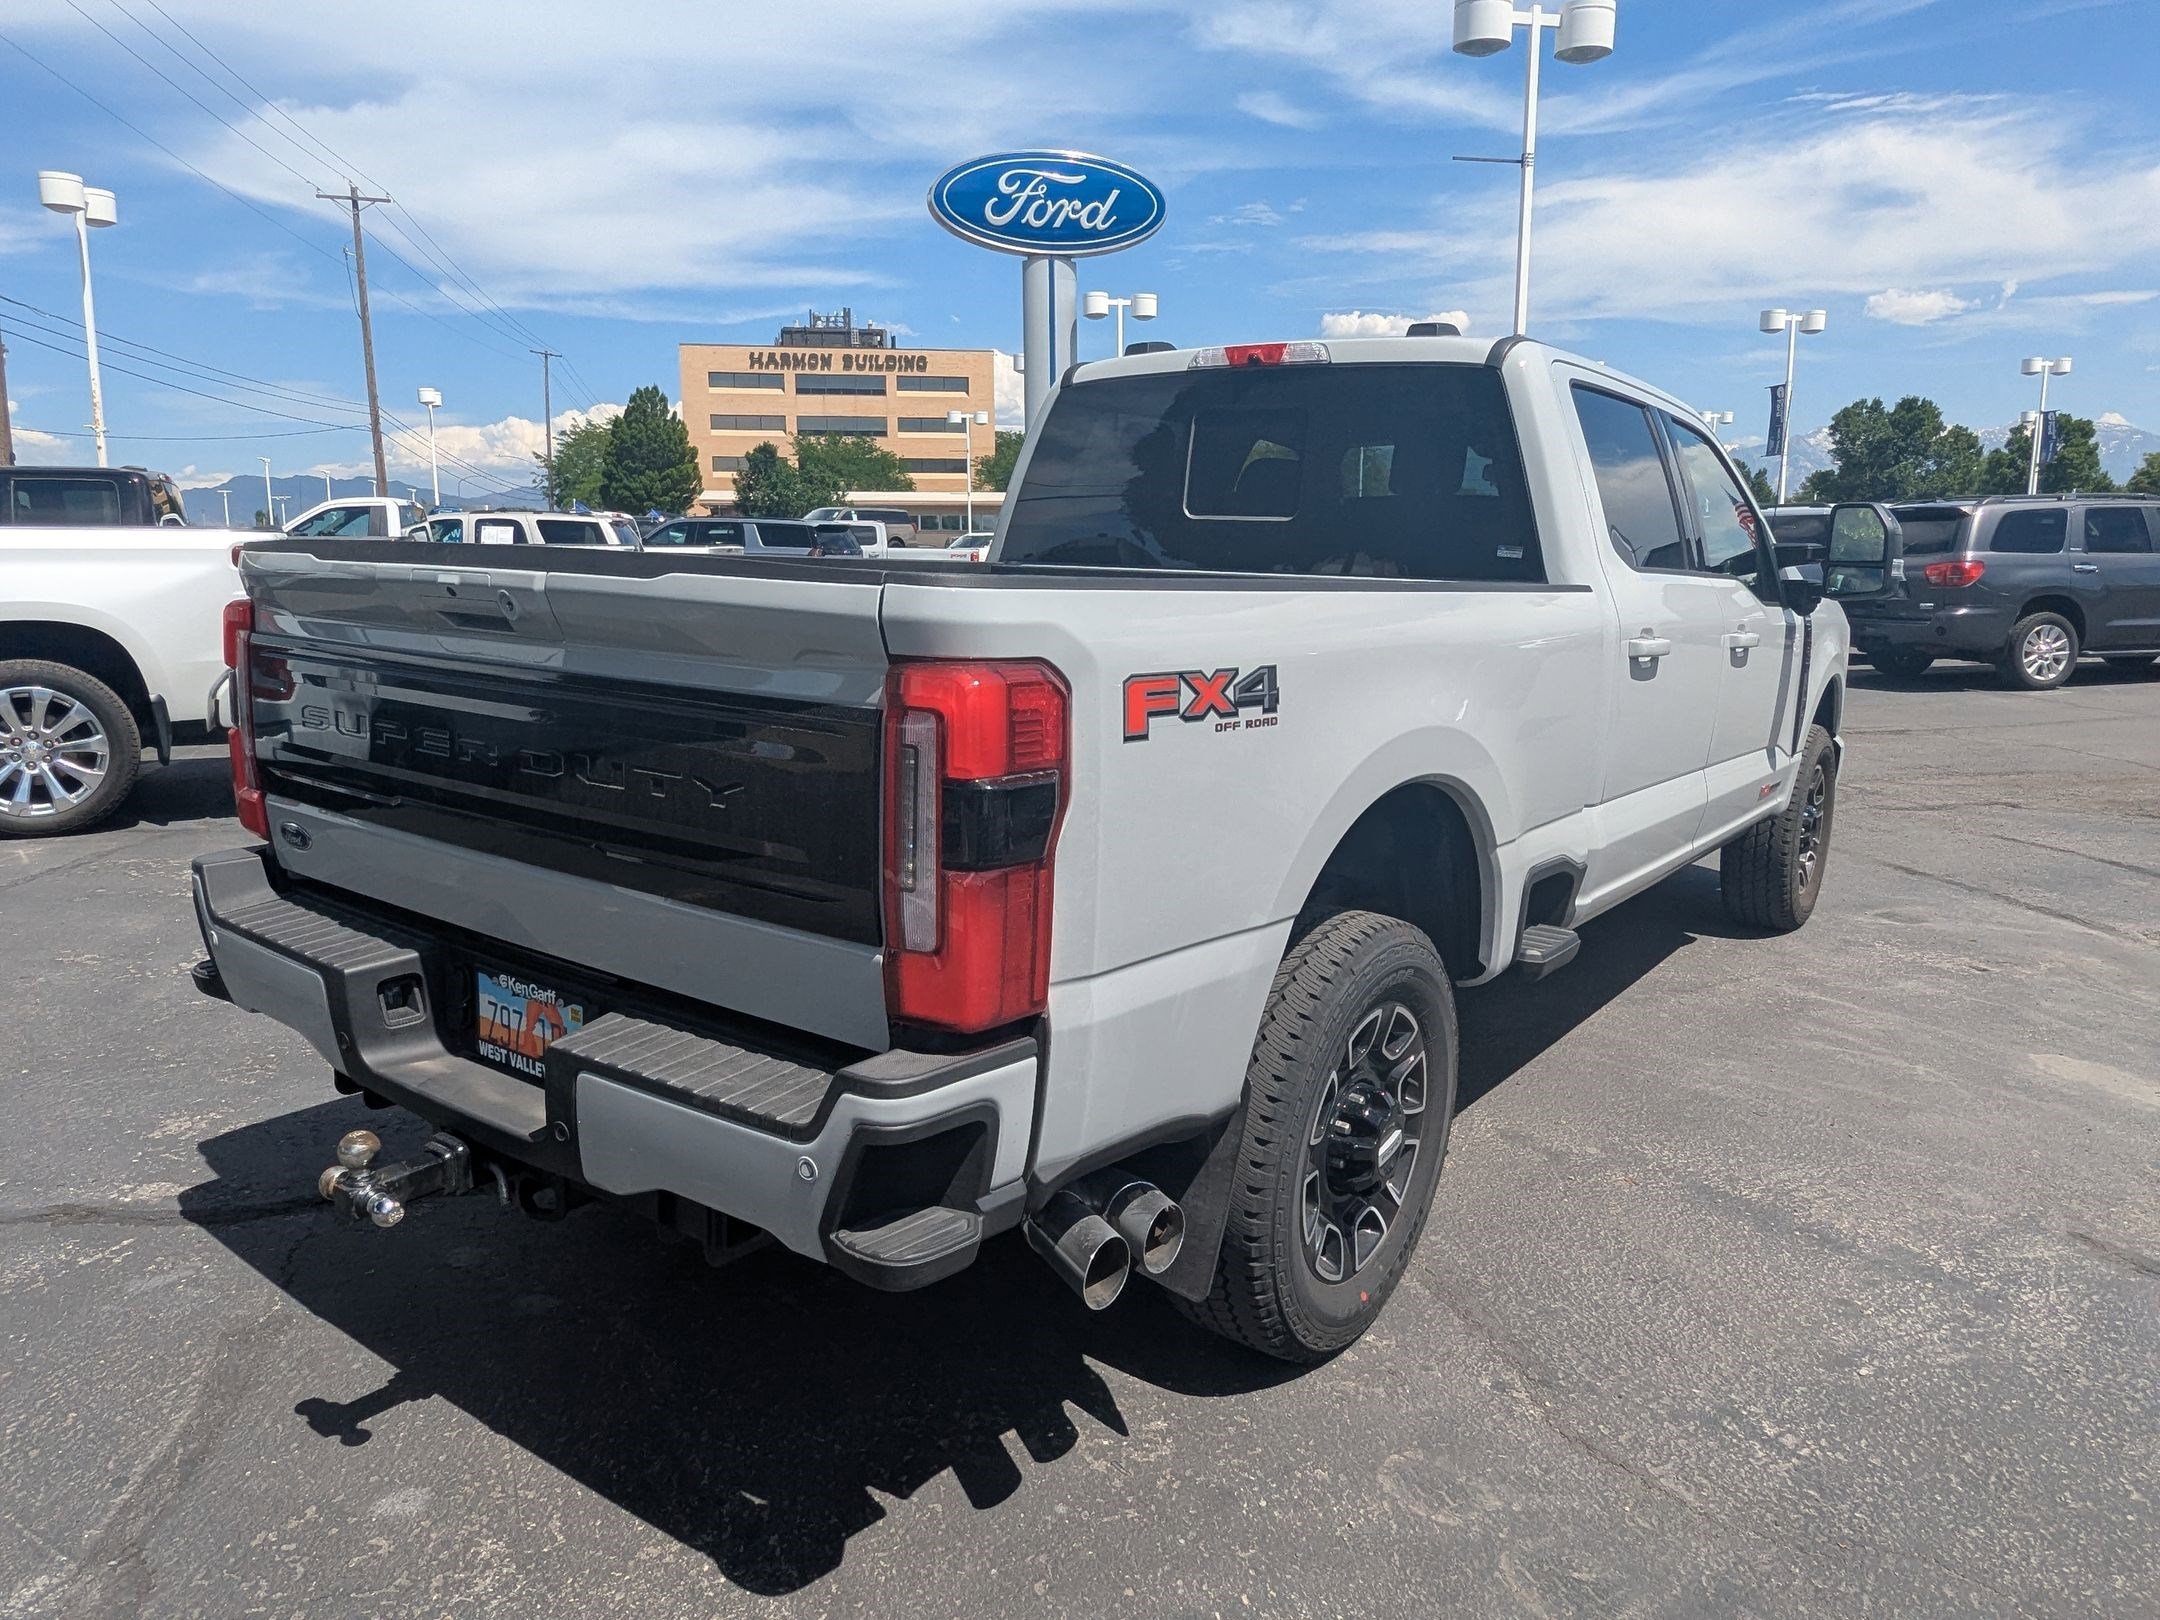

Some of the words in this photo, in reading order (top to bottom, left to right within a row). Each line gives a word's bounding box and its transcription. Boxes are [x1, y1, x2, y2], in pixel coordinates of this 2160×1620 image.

[984, 168, 1120, 231] Ford
[750, 351, 833, 371] HARMON
[842, 353, 928, 373] BUILDING
[1122, 664, 1280, 744] FX4
[1214, 721, 1241, 733] OFF
[1245, 716, 1279, 729] ROAD
[301, 704, 499, 767] SUPER
[519, 748, 745, 809] DUTY
[479, 1040, 508, 1065] WEST
